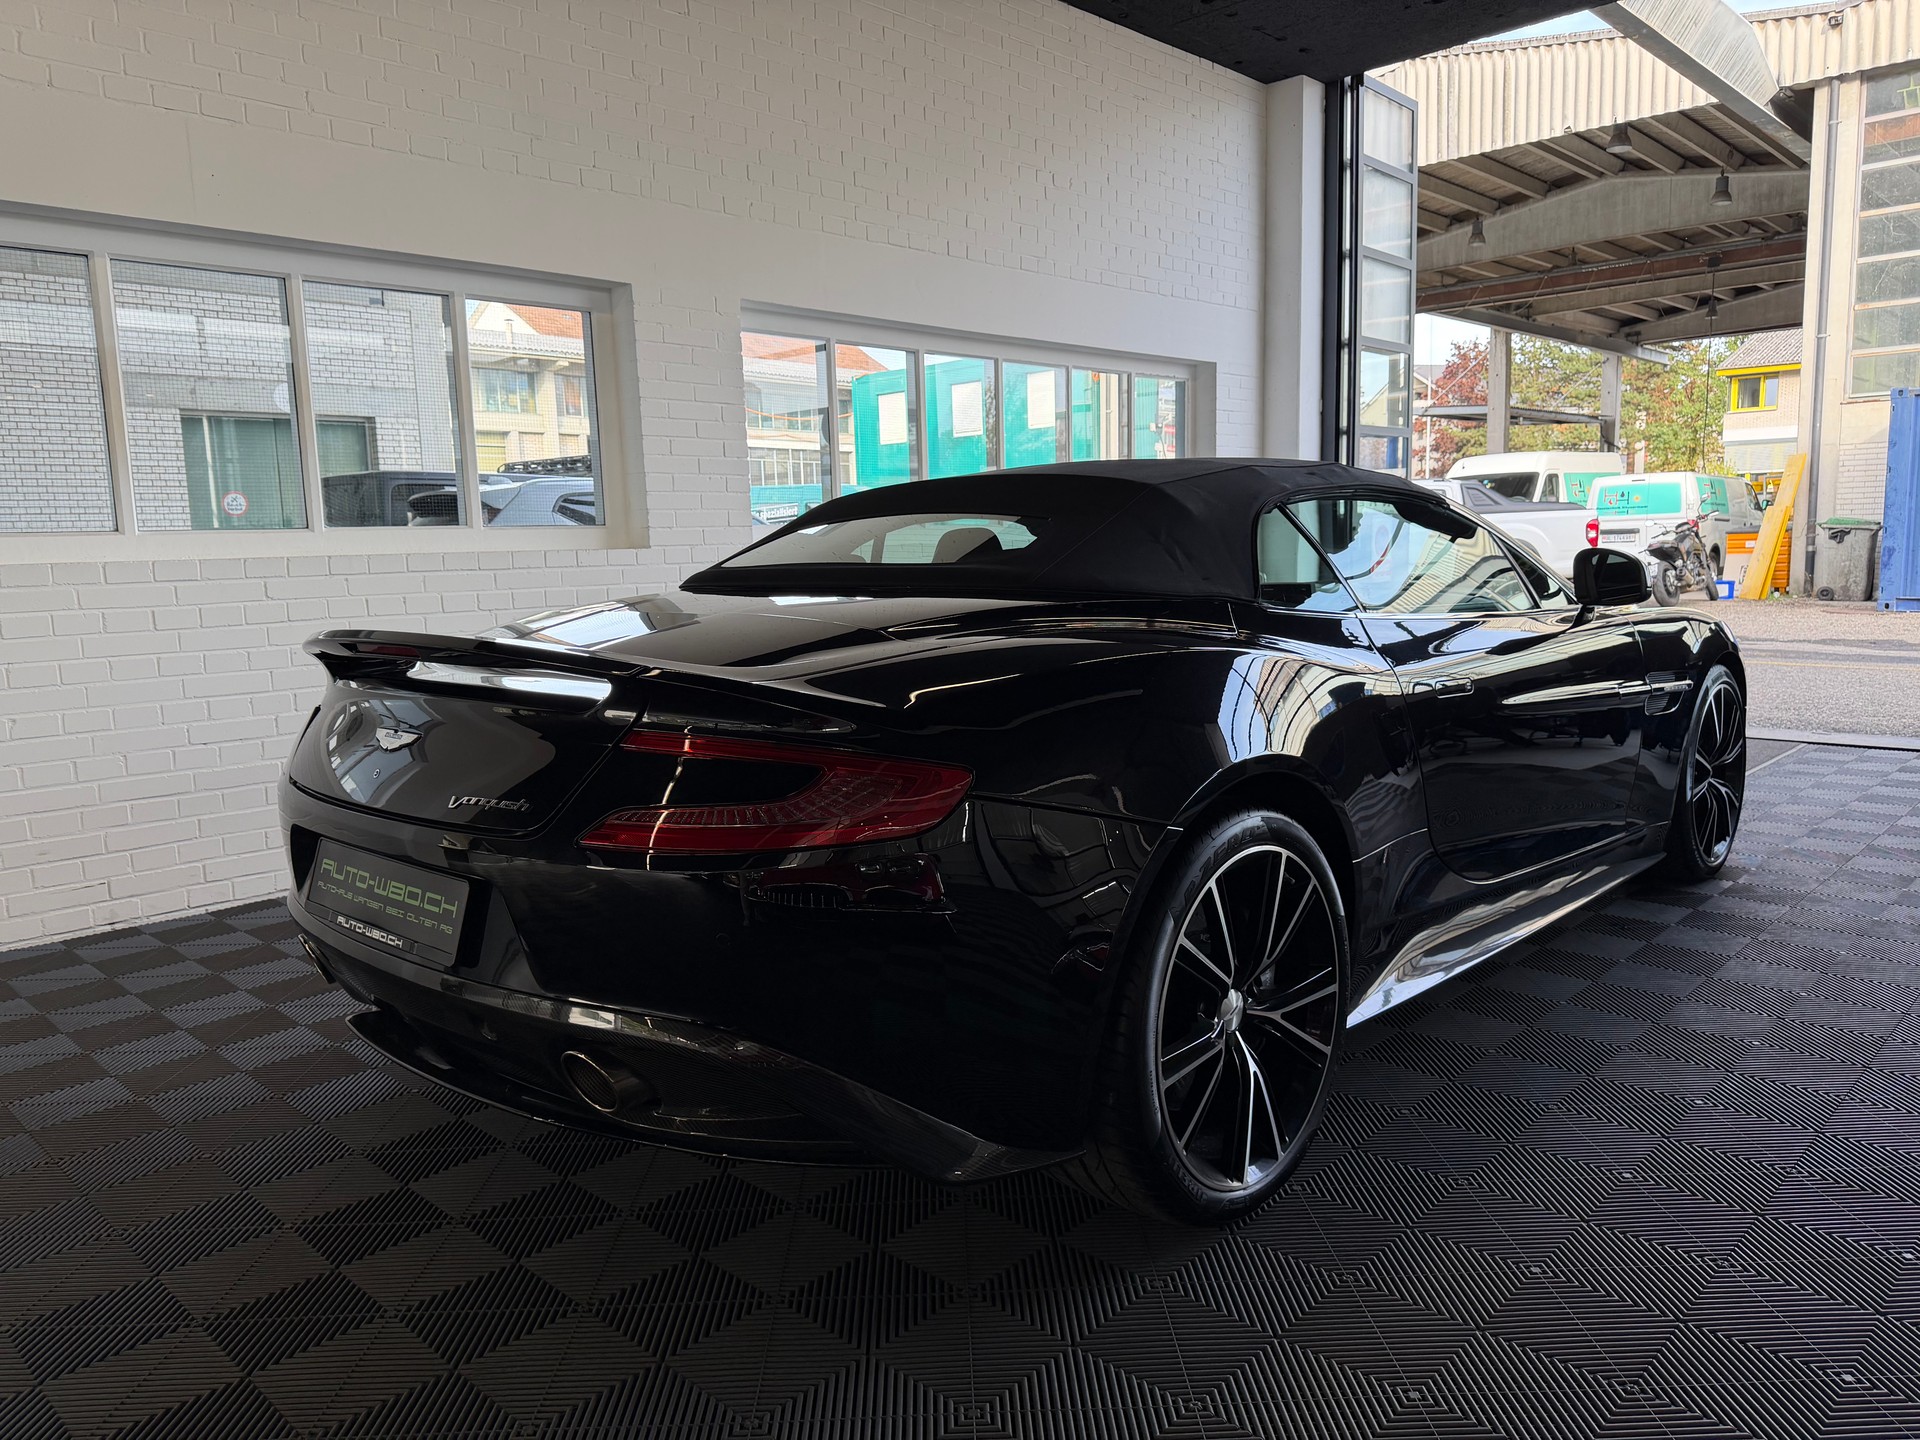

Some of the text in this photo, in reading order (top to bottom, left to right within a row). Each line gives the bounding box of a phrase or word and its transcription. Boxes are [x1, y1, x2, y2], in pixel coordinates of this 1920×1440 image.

[448, 795, 530, 811] Vanquish
[320, 858, 458, 918] AUTO-WBO.CH
[337, 916, 403, 948] AUTO-WBO.CH
[386, 906, 405, 918] BEI
[407, 913, 438, 929] OLTEN
[439, 924, 454, 935] AG
